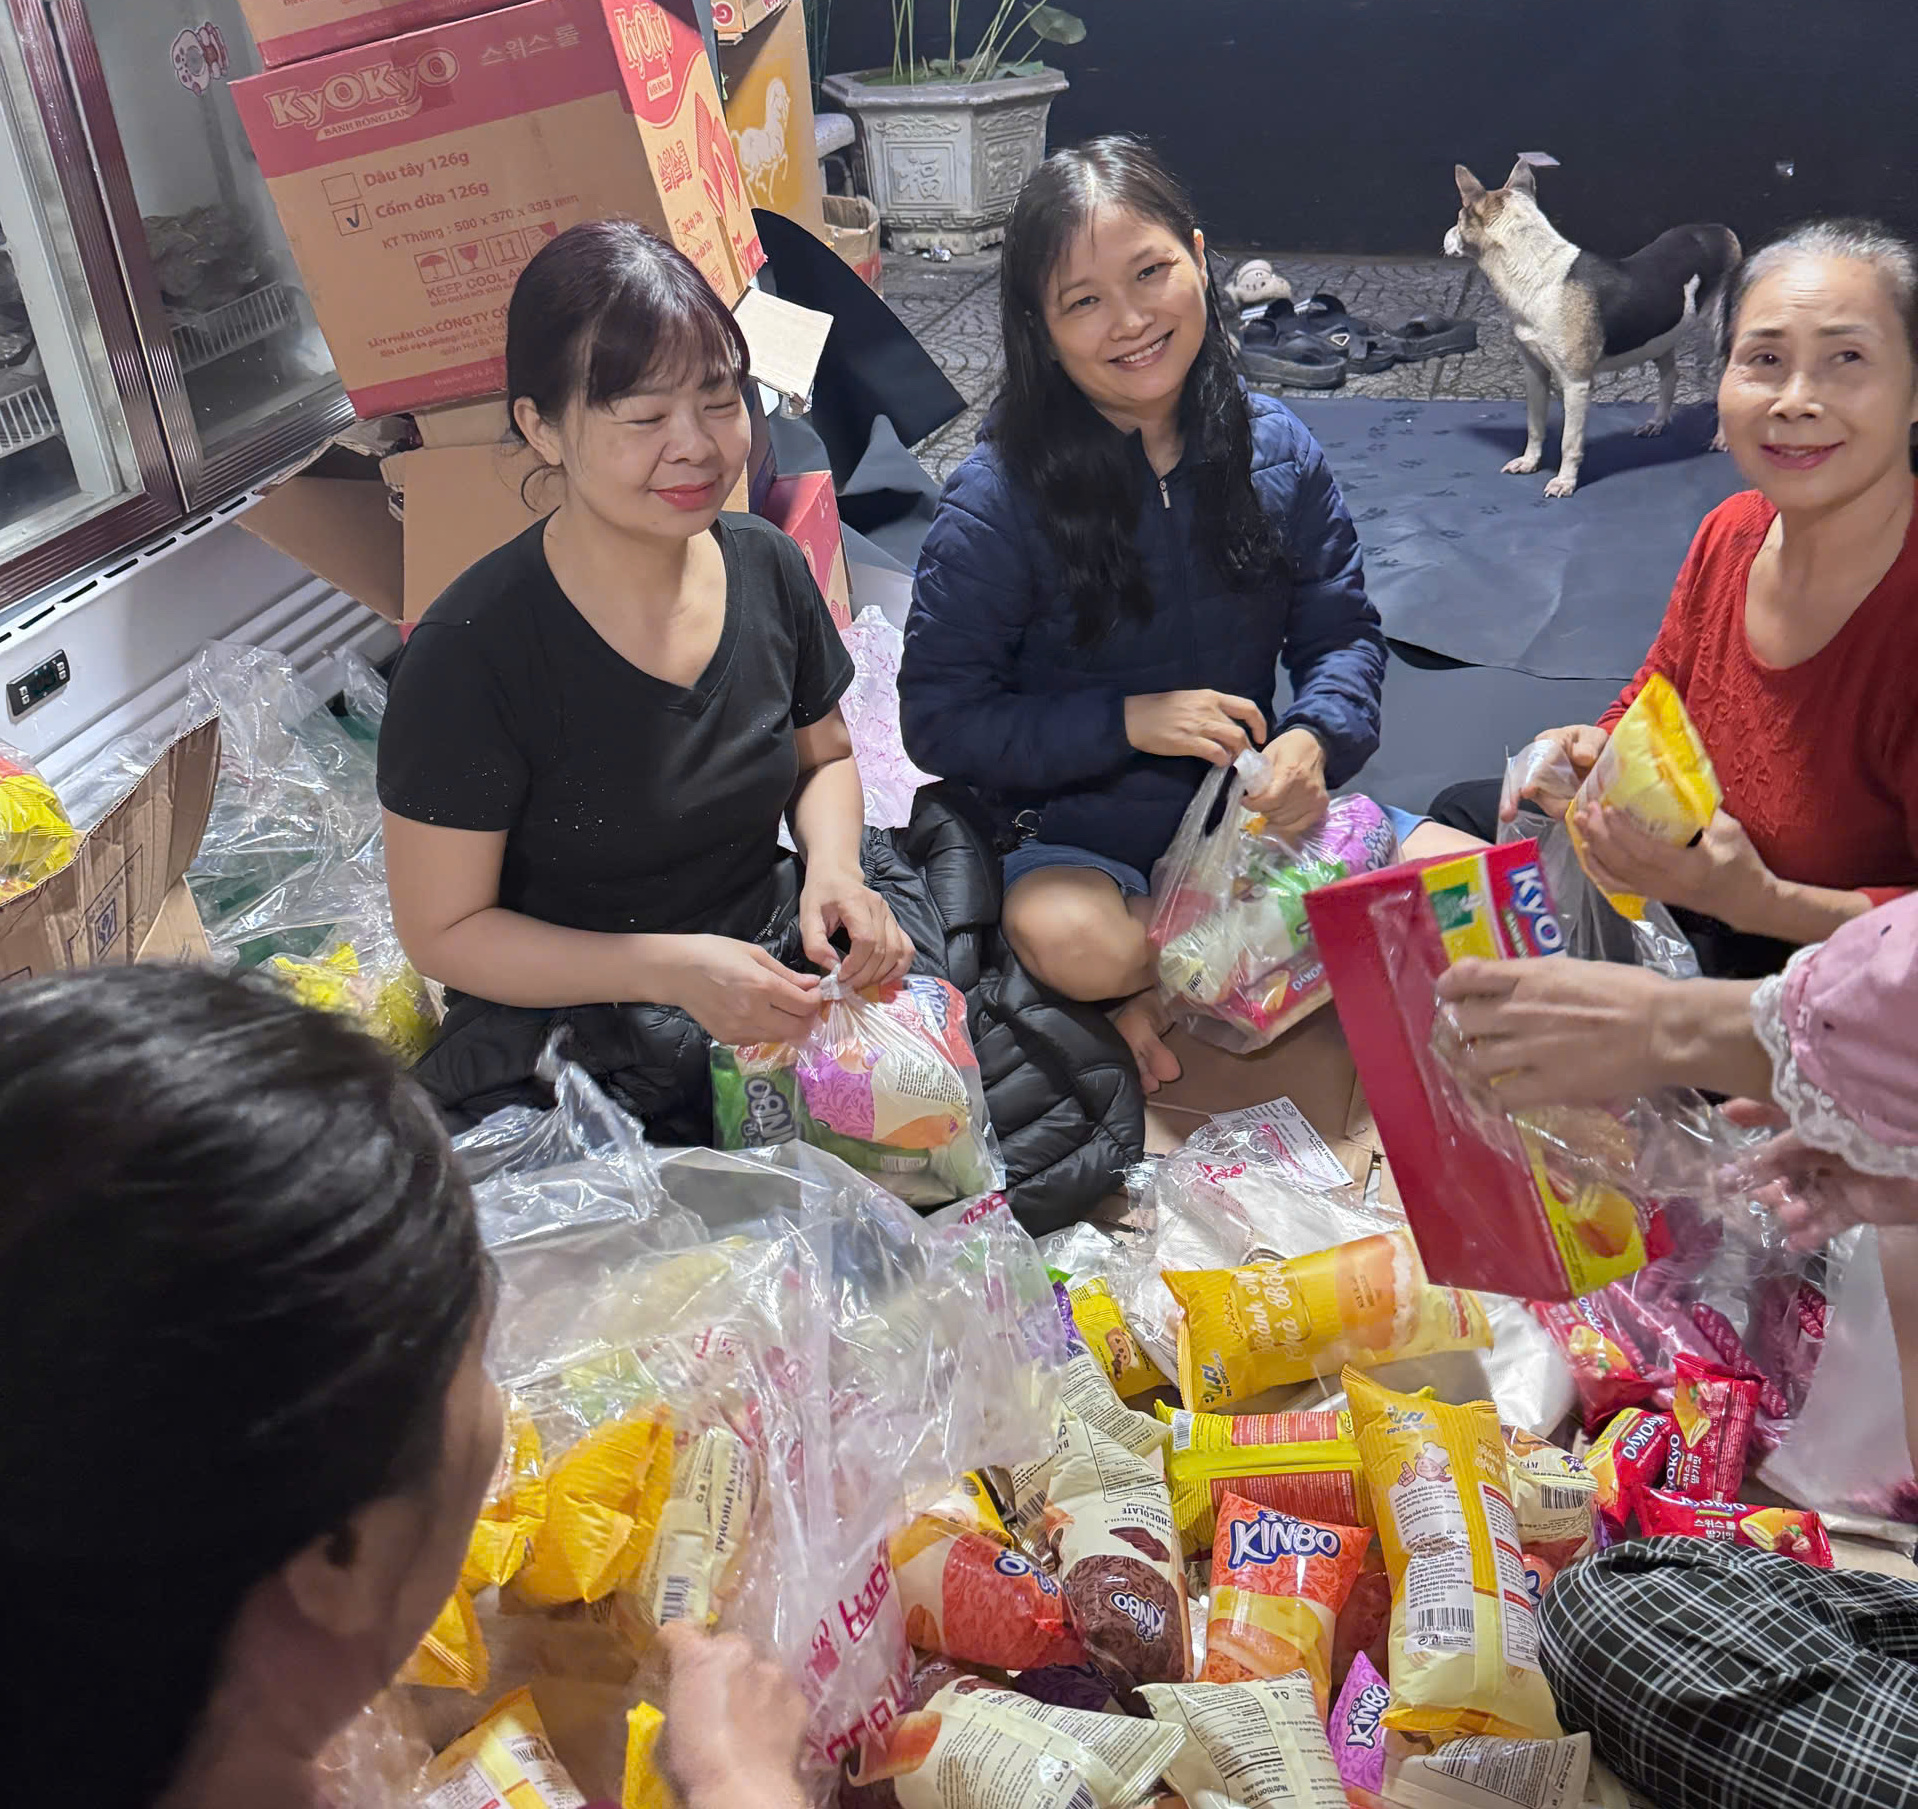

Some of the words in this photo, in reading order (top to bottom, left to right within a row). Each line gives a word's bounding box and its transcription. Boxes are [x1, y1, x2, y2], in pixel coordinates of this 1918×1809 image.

[363, 168, 398, 188] Dâu
[400, 160, 425, 180] tây
[428, 151, 471, 172] 126g
[375, 199, 412, 219] Cốm
[414, 192, 446, 210] dừa
[448, 181, 490, 199] 126g
[381, 236, 399, 250] KT
[402, 227, 446, 246] Thùng
[454, 218, 478, 233] 500
[491, 209, 513, 224] 370
[425, 281, 463, 299] KEEP
[465, 271, 507, 289] COOL
[744, 1075, 797, 1147] INBO
[1227, 1514, 1341, 1570] KINBO
[1110, 1591, 1167, 1636] KINBO
[1344, 1682, 1391, 1749] KINBO
[1258, 1783, 1289, 1798] Nutrition
